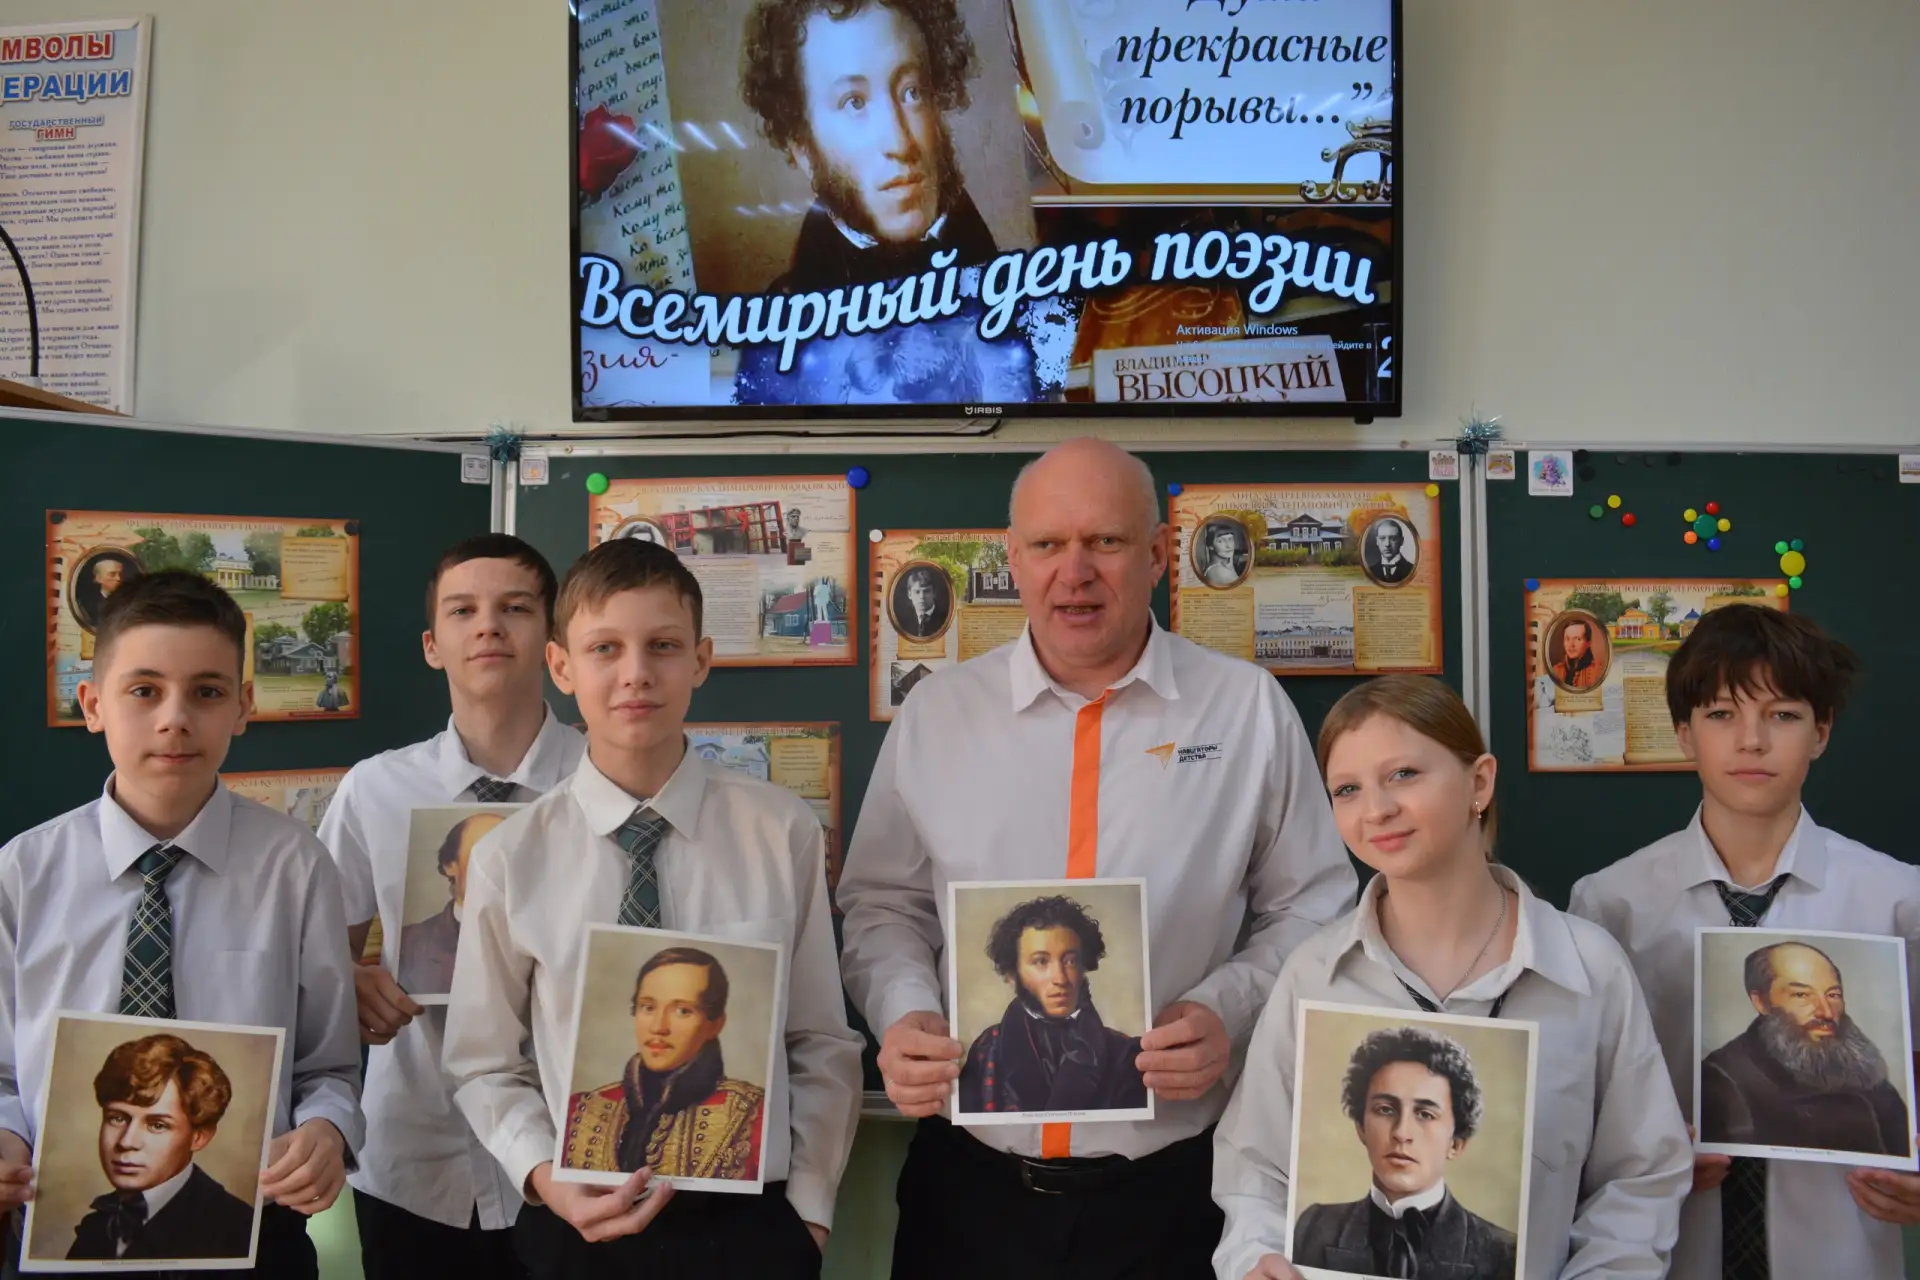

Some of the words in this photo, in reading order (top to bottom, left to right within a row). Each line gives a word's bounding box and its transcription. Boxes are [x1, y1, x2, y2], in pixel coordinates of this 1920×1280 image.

[1116, 26, 1388, 78] прекрасные
[9, 116, 104, 128] ГОСУДАРСТВЕННЫЙ
[37, 127, 75, 139] ГИМН
[579, 249, 962, 372] Всемирный
[980, 239, 1132, 338] день
[1151, 231, 1376, 313] поэзии
[1176, 324, 1240, 337] Активация
[1244, 324, 1298, 336] Windows
[1117, 355, 1335, 402] ВЫСОЦКИЙ
[974, 406, 1003, 414] IRBIS
